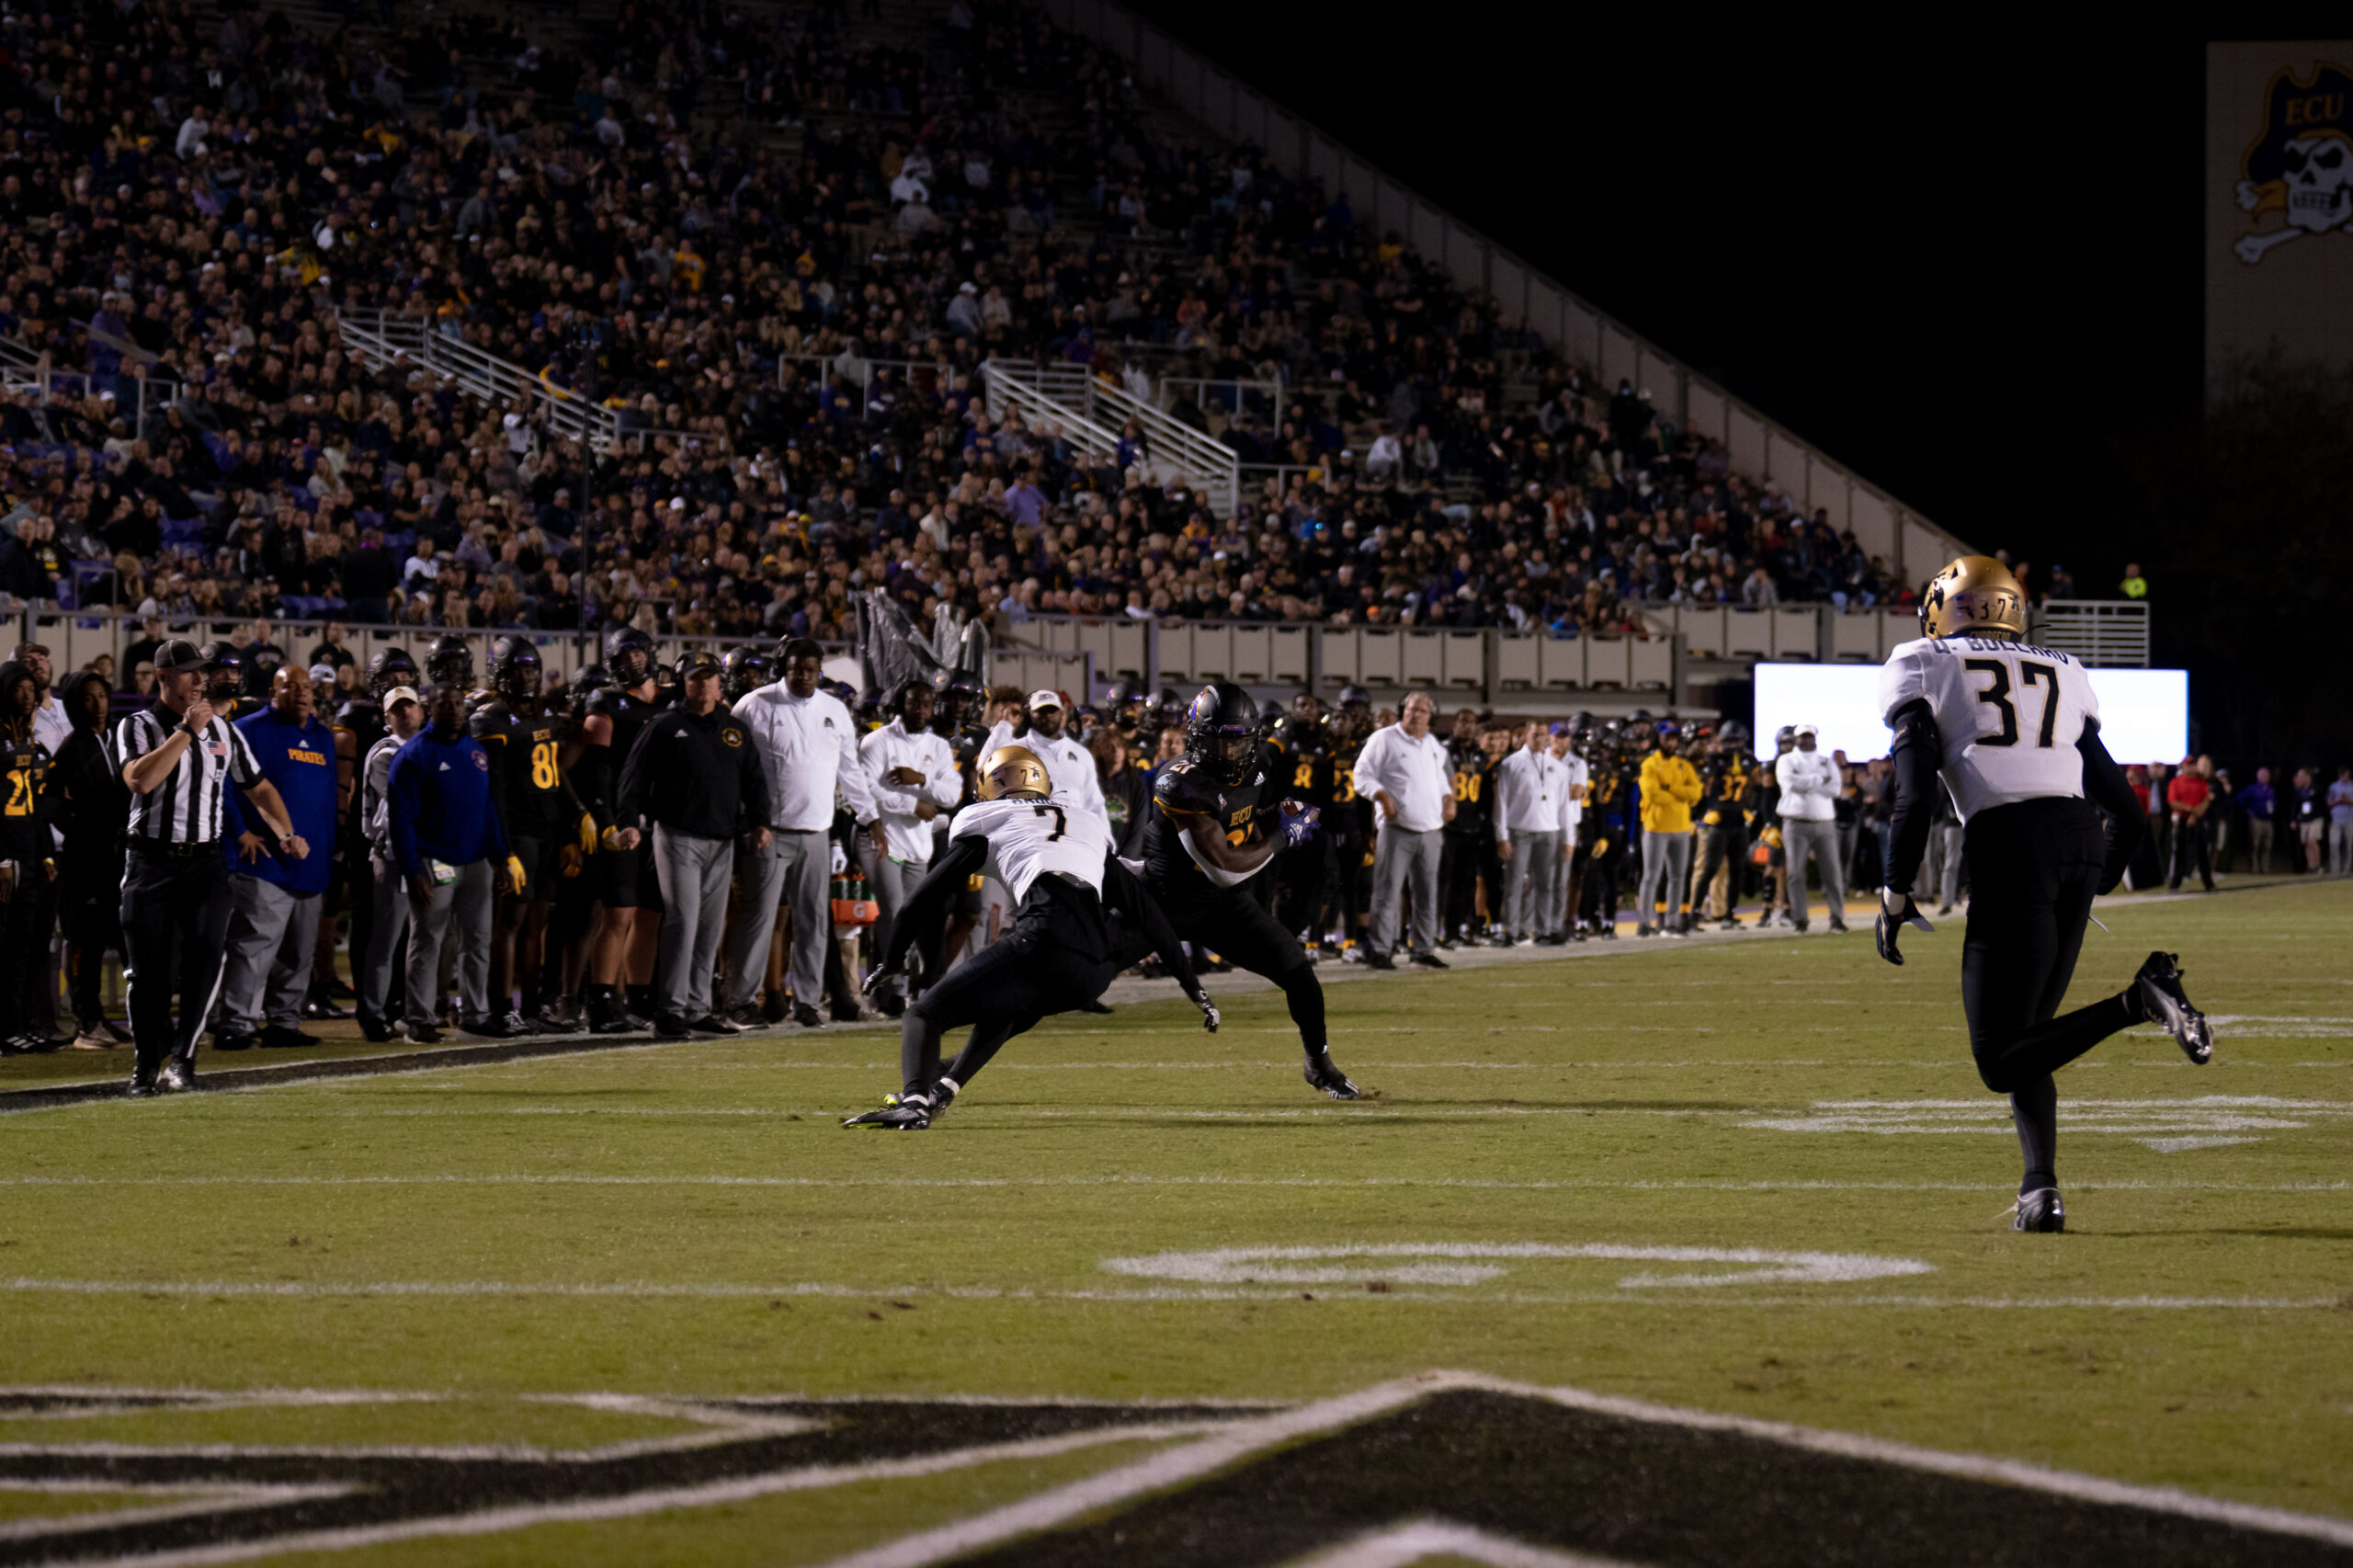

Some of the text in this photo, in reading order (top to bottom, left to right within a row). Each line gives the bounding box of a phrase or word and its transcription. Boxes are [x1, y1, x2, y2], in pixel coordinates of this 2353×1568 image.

[2286, 92, 2346, 126] ECU
[1980, 598, 2006, 619] 37
[1964, 657, 2060, 748] 37
[287, 747, 327, 767] PIRATES
[530, 741, 560, 790] 81
[5, 767, 34, 816] 21
[1020, 769, 1028, 785] 7
[1454, 772, 1482, 803] 80
[1718, 774, 1748, 801] 37
[1032, 805, 1066, 842] 7
[1229, 804, 1254, 827] ECU
[853, 903, 865, 918] G
